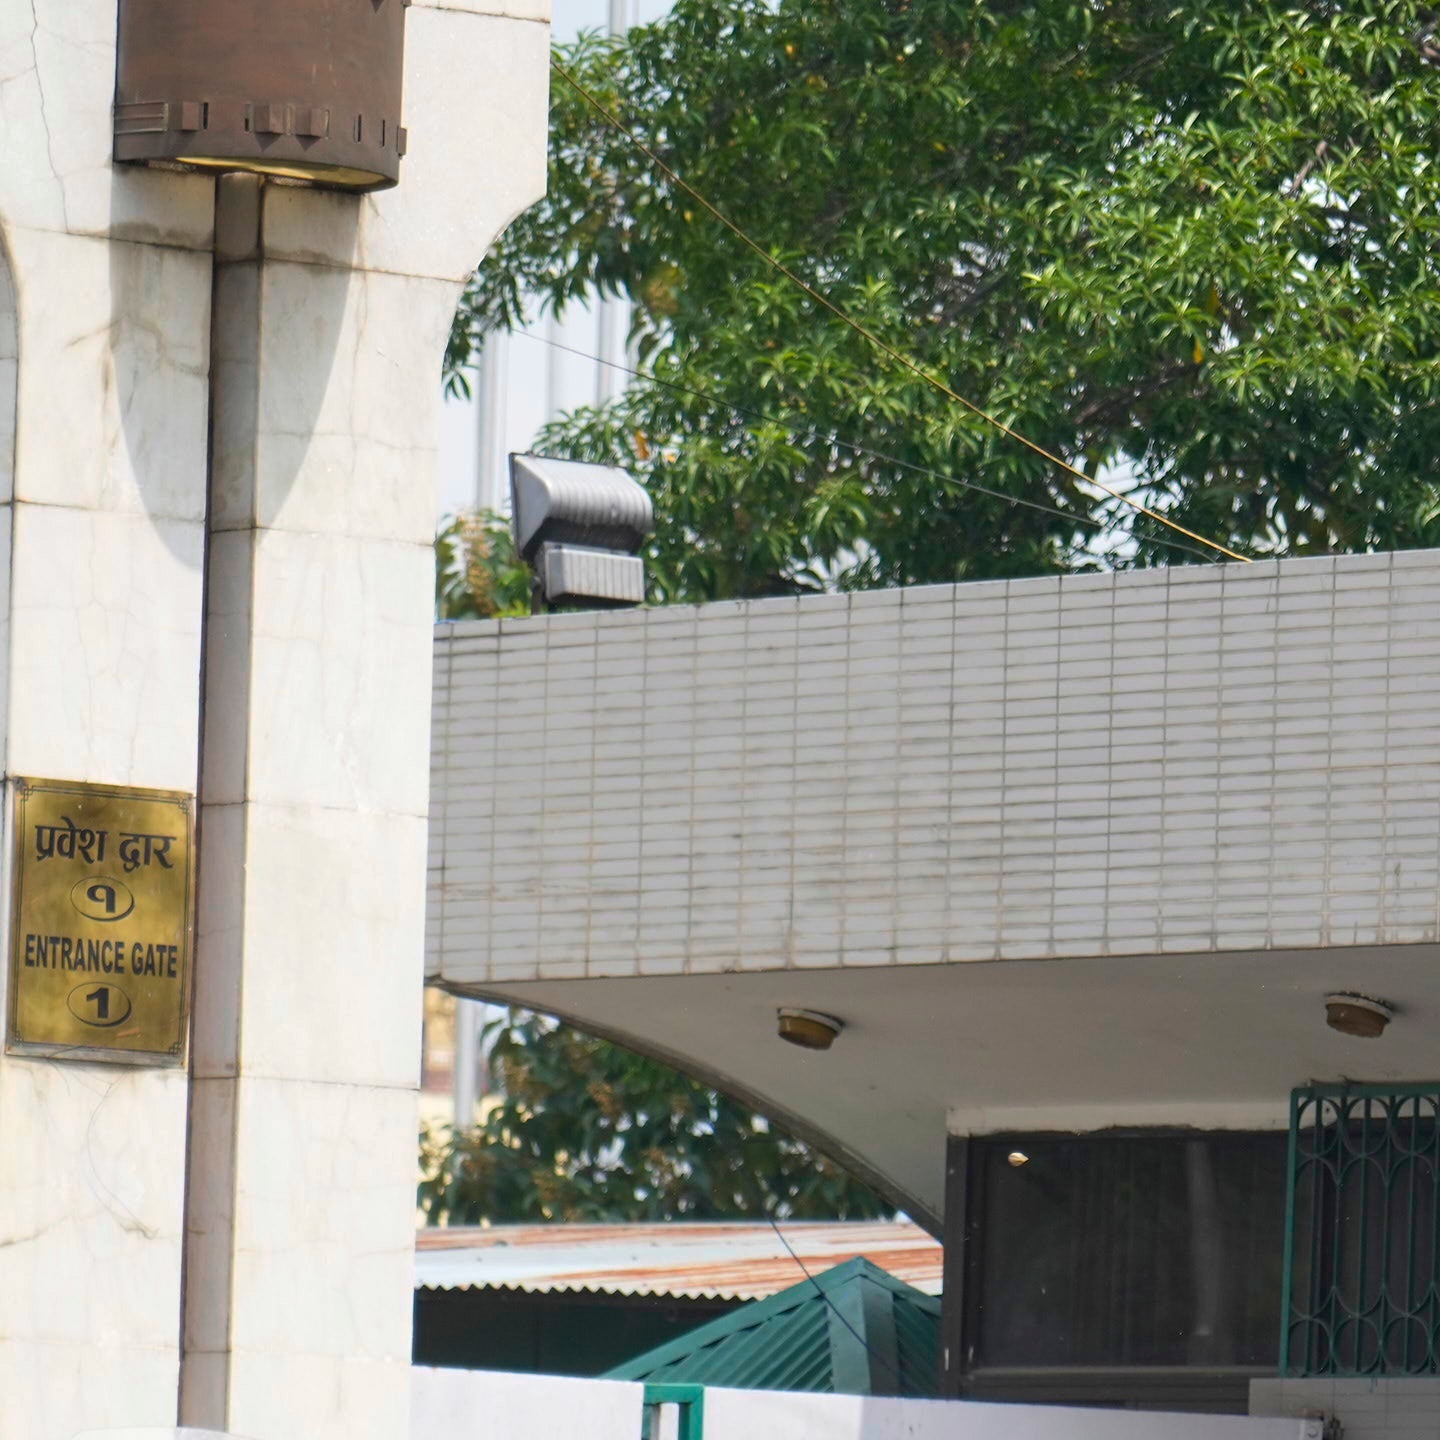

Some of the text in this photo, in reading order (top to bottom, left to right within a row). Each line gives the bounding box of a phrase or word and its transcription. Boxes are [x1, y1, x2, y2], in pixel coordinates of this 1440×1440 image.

[34, 816, 176, 873] प्रवेश द्वार
[25, 934, 178, 978] ENTRANCE GATE
[86, 987, 110, 1019] 1
